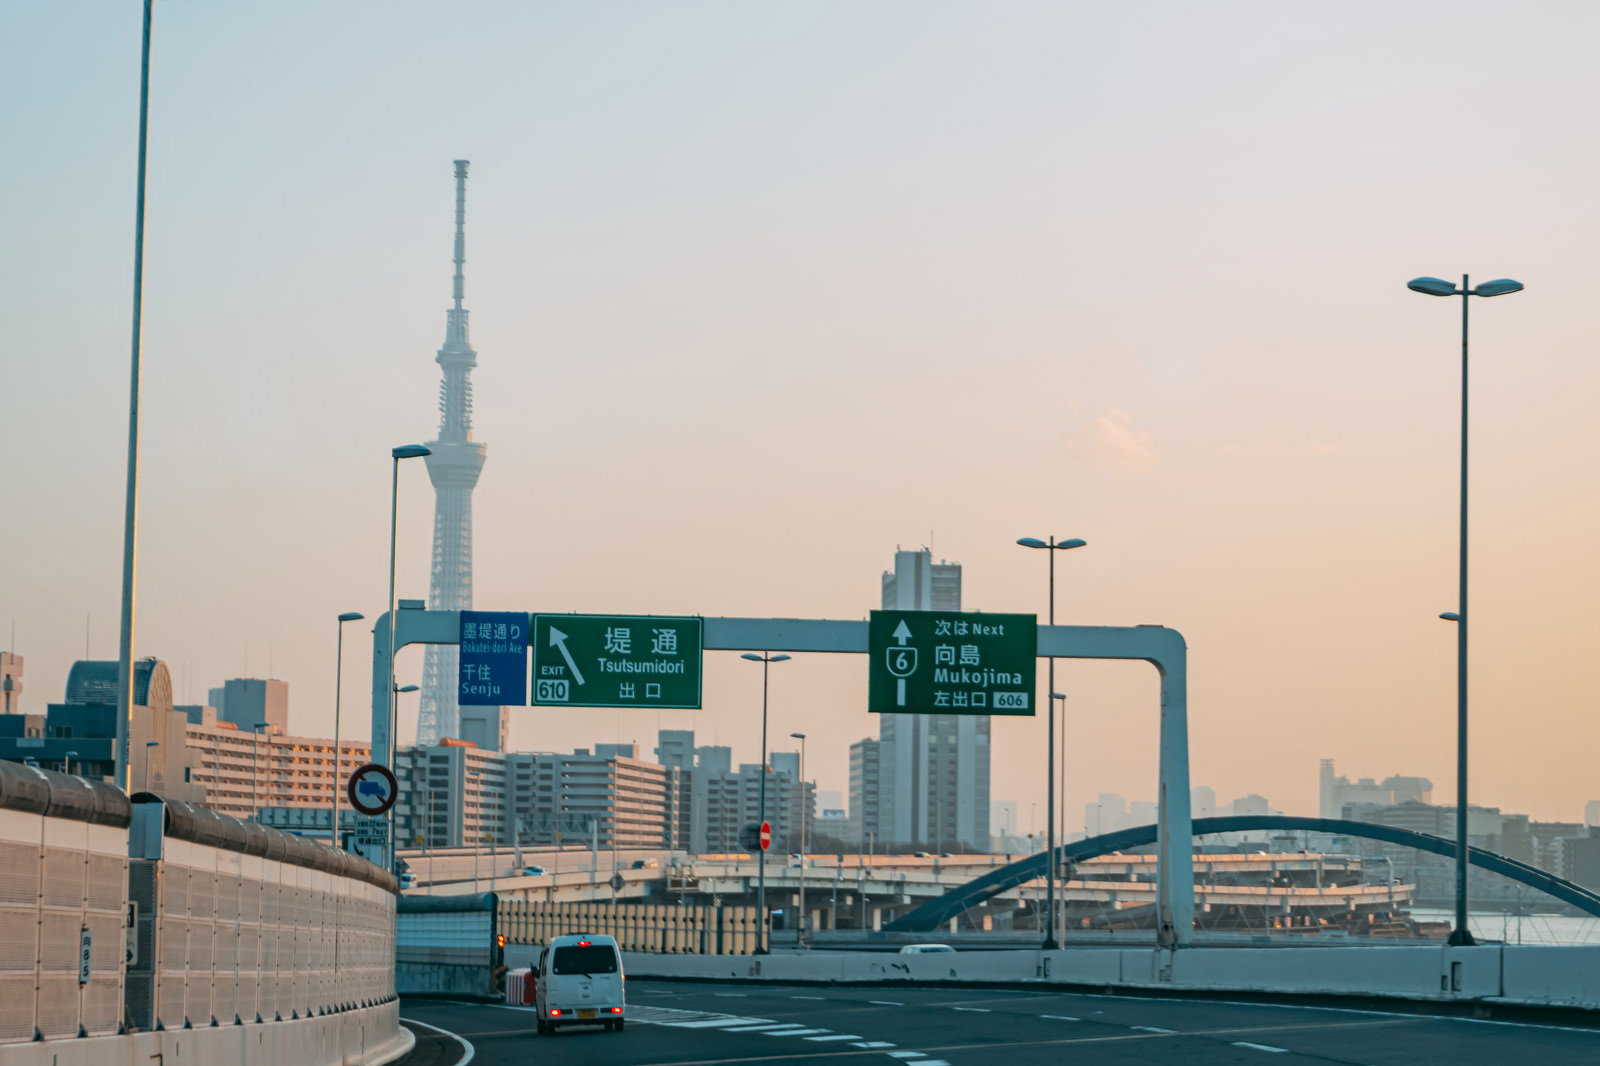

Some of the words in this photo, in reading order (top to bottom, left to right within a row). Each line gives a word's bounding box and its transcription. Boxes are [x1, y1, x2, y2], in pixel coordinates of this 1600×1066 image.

[463, 623, 521, 640] 墨堤通り
[935, 619, 969, 636] 次は
[972, 623, 1005, 636] Next
[462, 641, 508, 653] Bokutei-dori
[509, 643, 522, 654] Ave
[604, 627, 678, 655] 堤通
[896, 652, 908, 670] 6
[935, 643, 980, 666] 向島
[462, 664, 492, 681] 千住
[541, 665, 565, 676] EXIT
[598, 657, 684, 674] Tsutsumidori
[934, 668, 1022, 688] Mukojima
[462, 682, 501, 697] Senju
[538, 681, 566, 699] 610
[619, 682, 661, 699] 出口
[934, 690, 987, 707] 左出口
[998, 694, 1023, 706] 606
